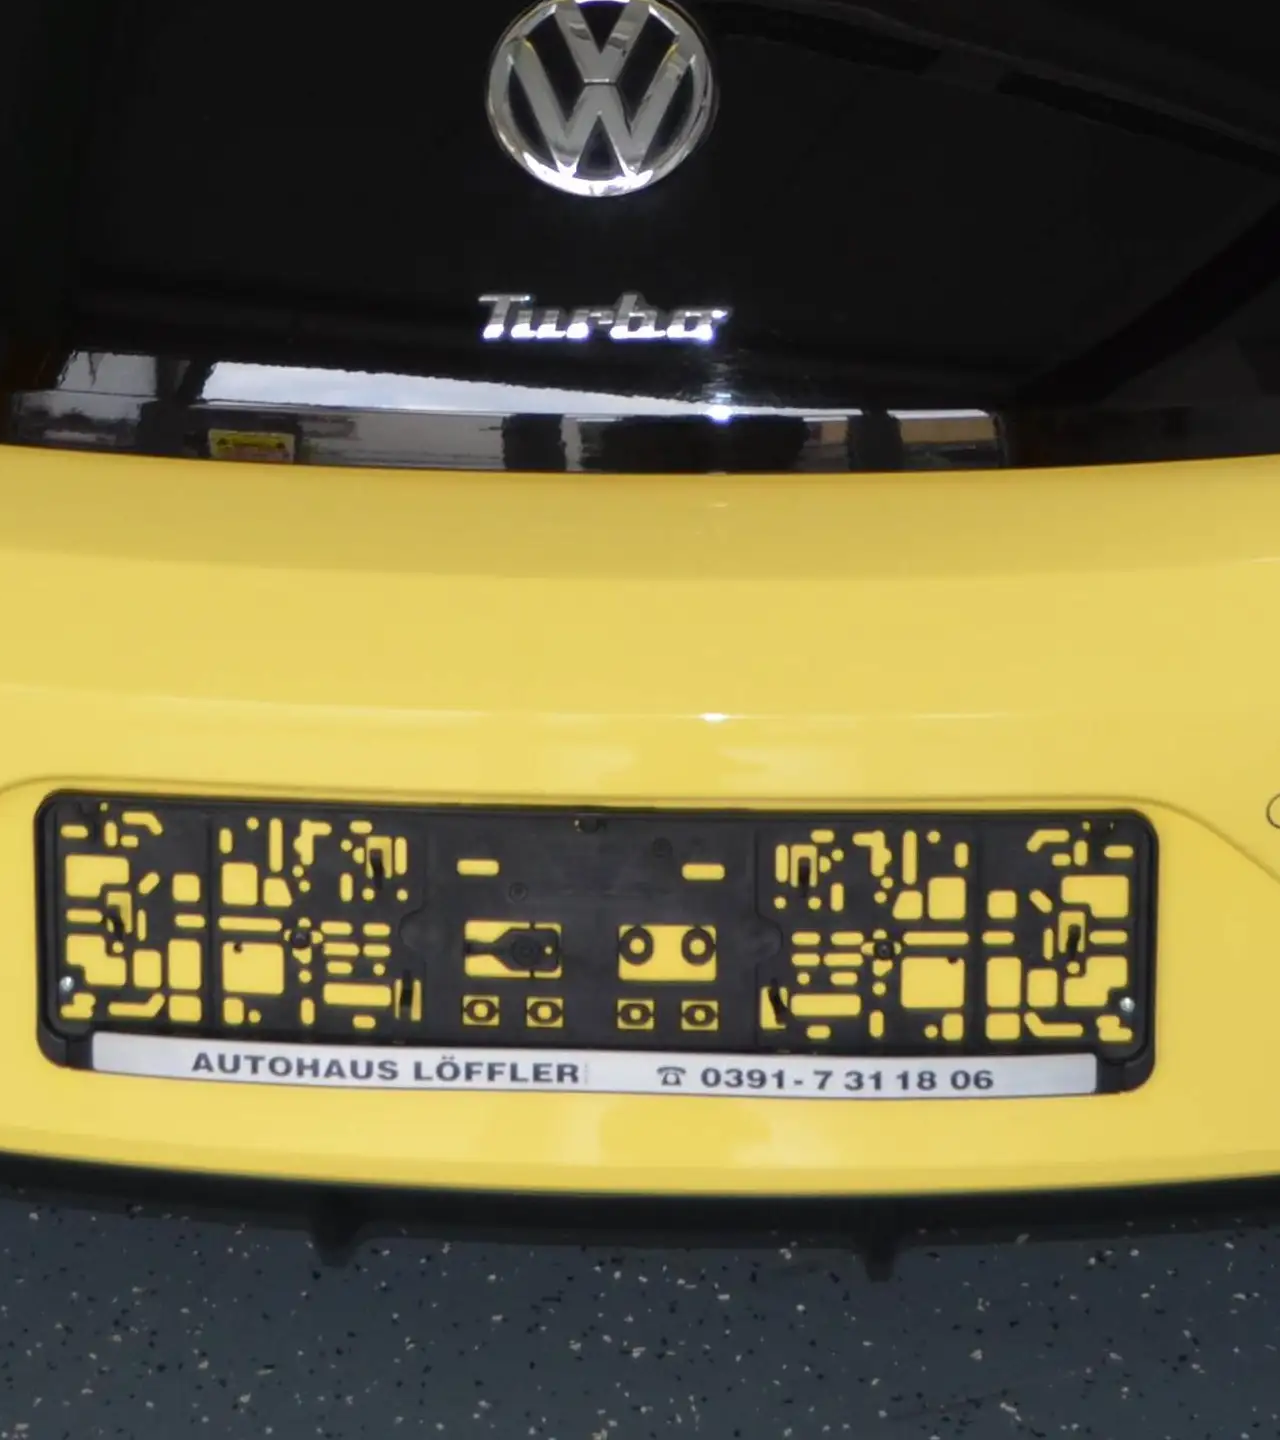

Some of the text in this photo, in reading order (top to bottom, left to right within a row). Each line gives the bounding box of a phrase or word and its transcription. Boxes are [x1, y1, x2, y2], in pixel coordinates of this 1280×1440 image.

[478, 291, 732, 341] Turbo
[192, 1051, 399, 1081] AUTOHAUS
[414, 1054, 580, 1084] LÖFFLER
